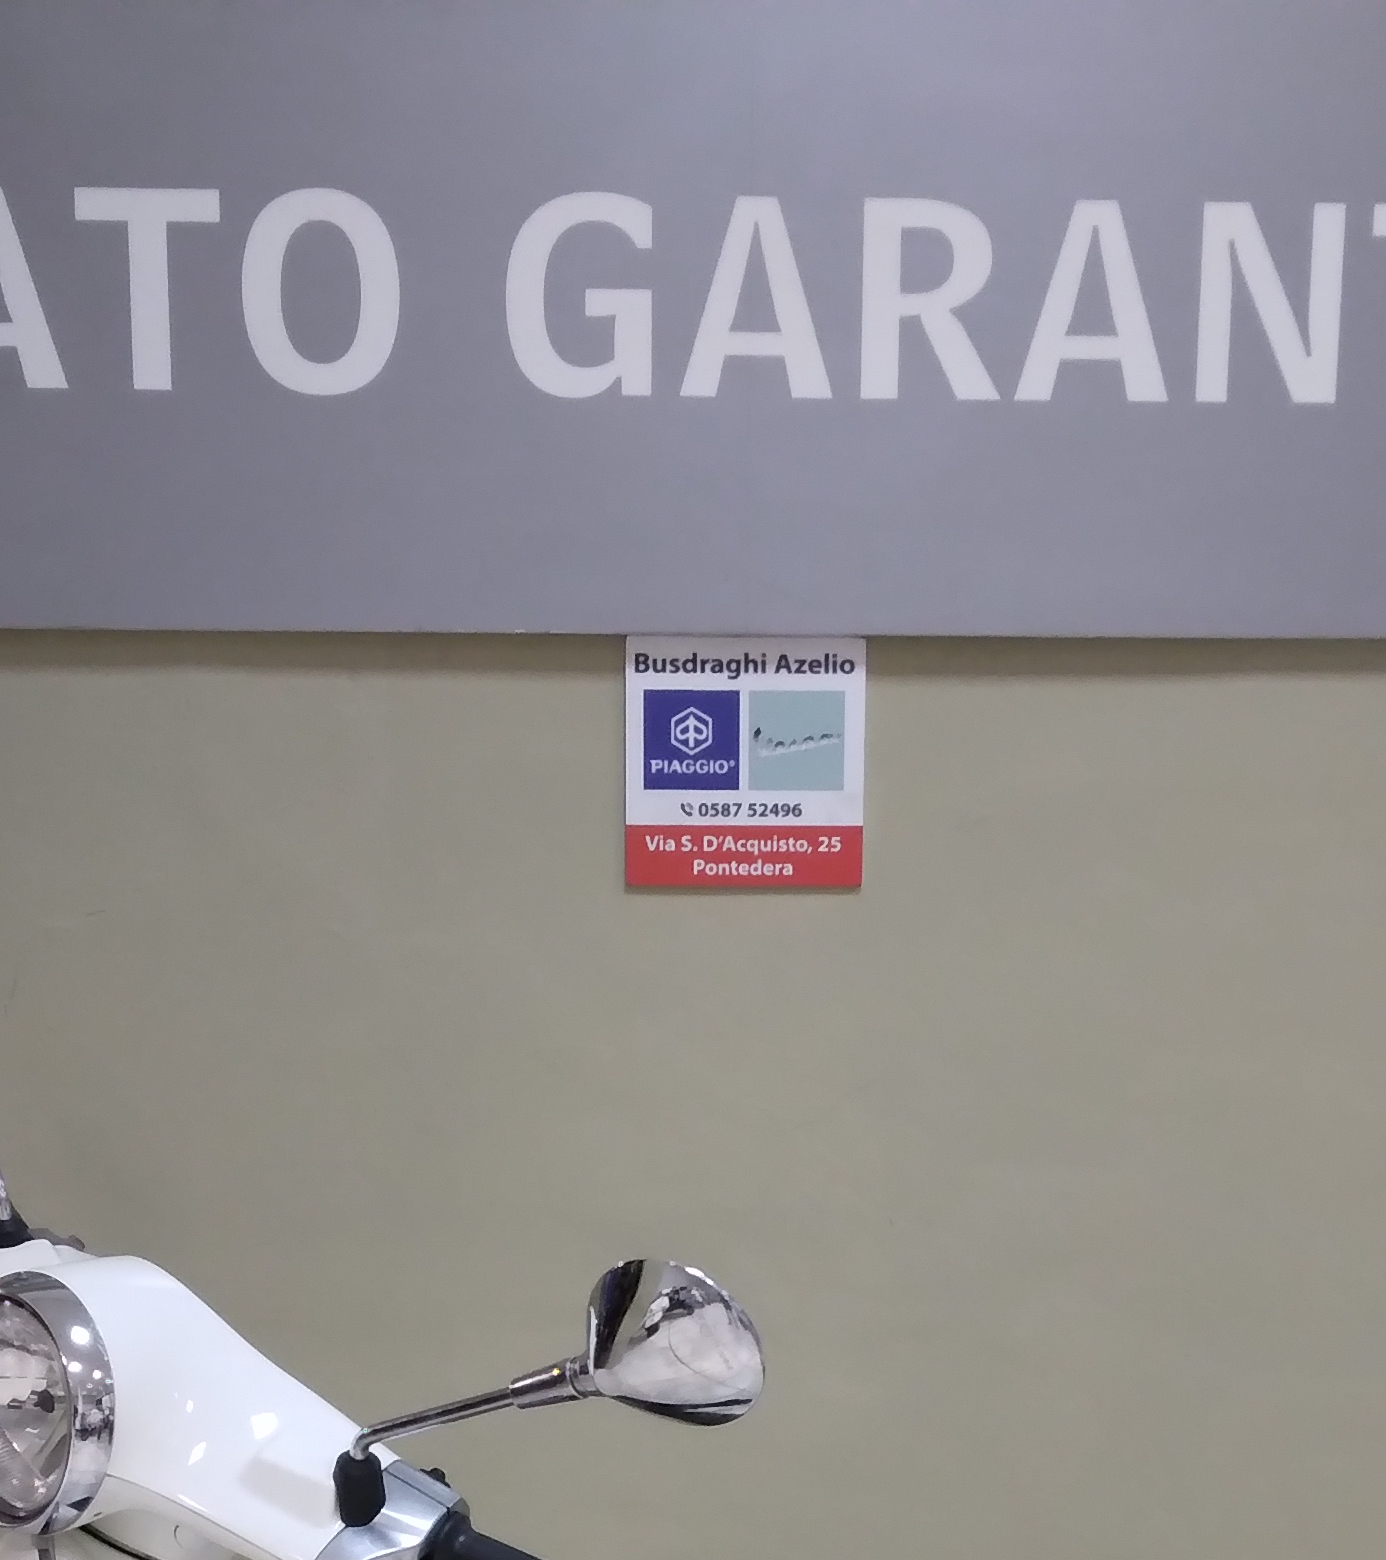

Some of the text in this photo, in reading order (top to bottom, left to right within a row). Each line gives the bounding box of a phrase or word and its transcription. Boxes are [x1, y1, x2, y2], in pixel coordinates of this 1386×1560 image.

[634, 653, 856, 680] Busdraghi Azelio
[698, 803, 803, 818] 0587 52496
[645, 836, 842, 856] Via S. D'Acquisto, 25
[693, 859, 794, 876] Pontedera
